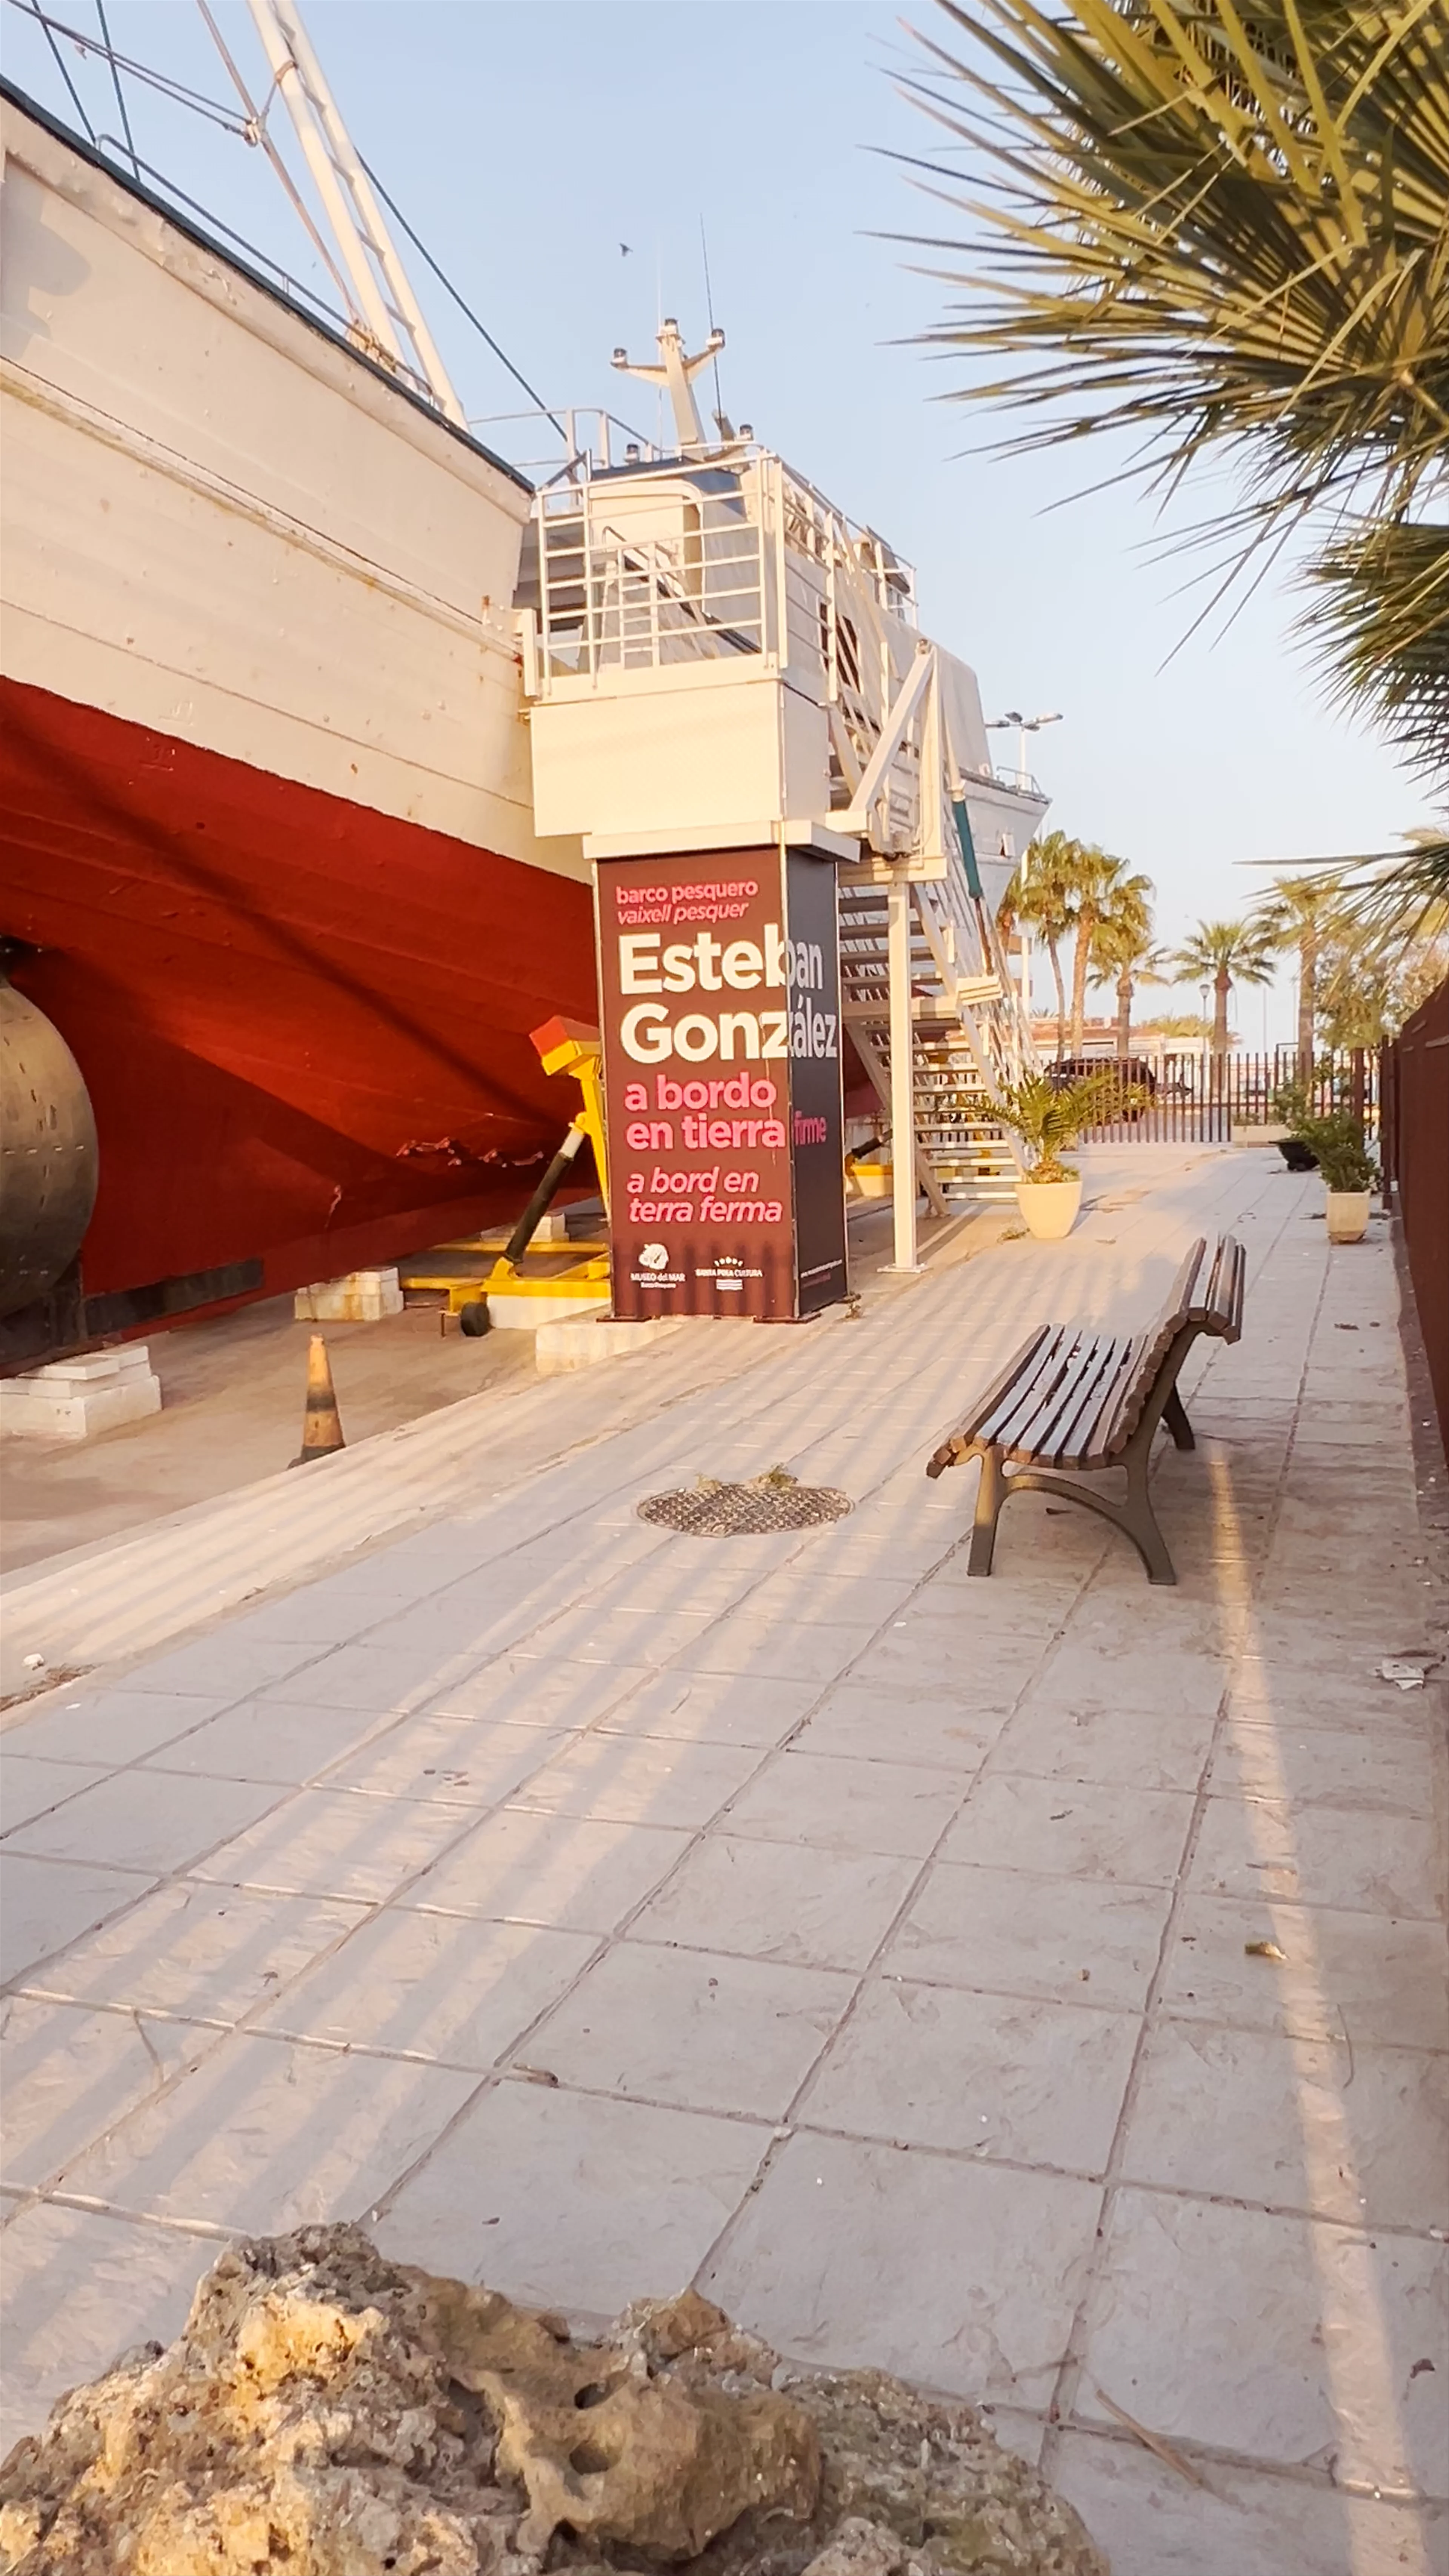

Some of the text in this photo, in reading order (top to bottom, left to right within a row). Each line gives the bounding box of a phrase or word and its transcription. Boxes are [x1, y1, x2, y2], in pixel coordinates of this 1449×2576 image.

[616, 881, 758, 904] barco pesquero
[618, 903, 749, 924] vaixell pesquer
[619, 923, 823, 995] Esteban
[621, 994, 837, 1064] González
[625, 1072, 776, 1112] a bordo
[626, 1110, 826, 1149] en tierra firme
[627, 1167, 759, 1193] a bord en
[630, 1195, 783, 1222] terra ferma
